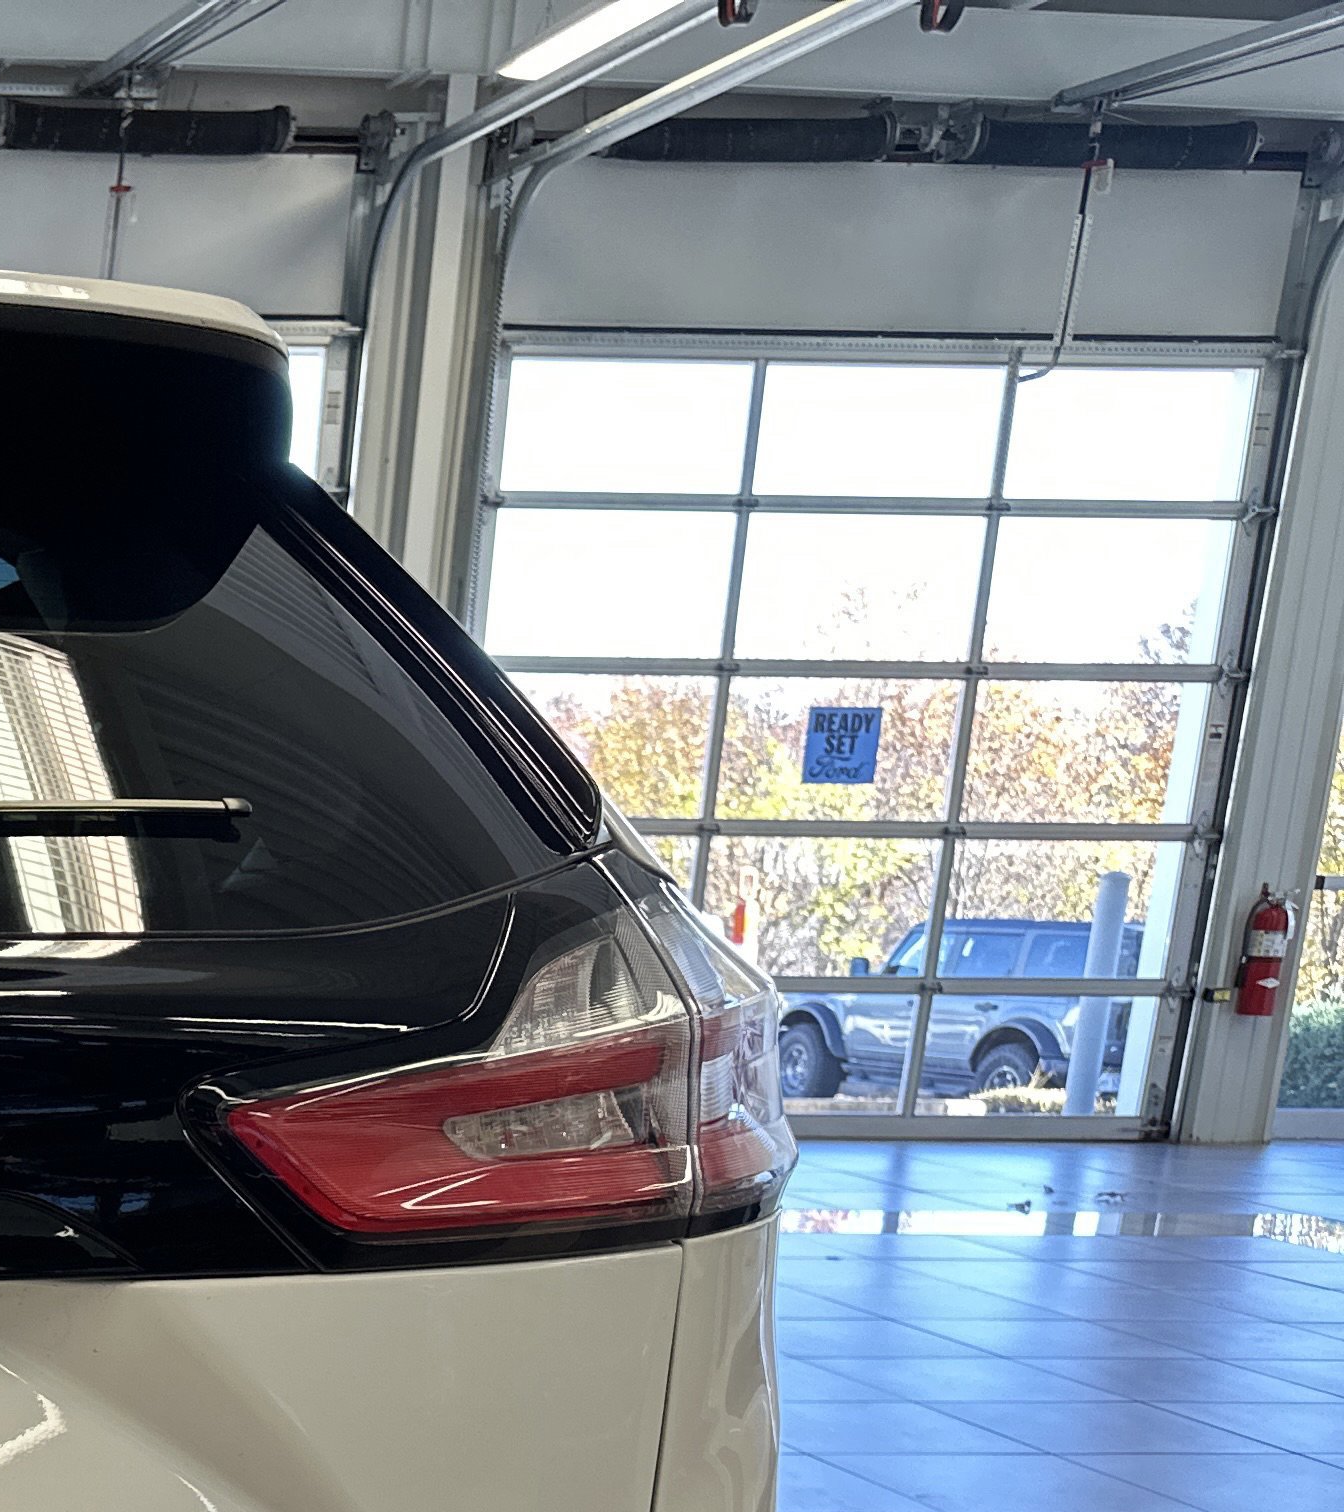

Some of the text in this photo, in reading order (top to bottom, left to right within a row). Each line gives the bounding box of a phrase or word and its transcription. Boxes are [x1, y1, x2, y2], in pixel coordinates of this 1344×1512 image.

[814, 713, 875, 733] READY
[824, 735, 859, 755] SET
[808, 755, 870, 779] Ford
